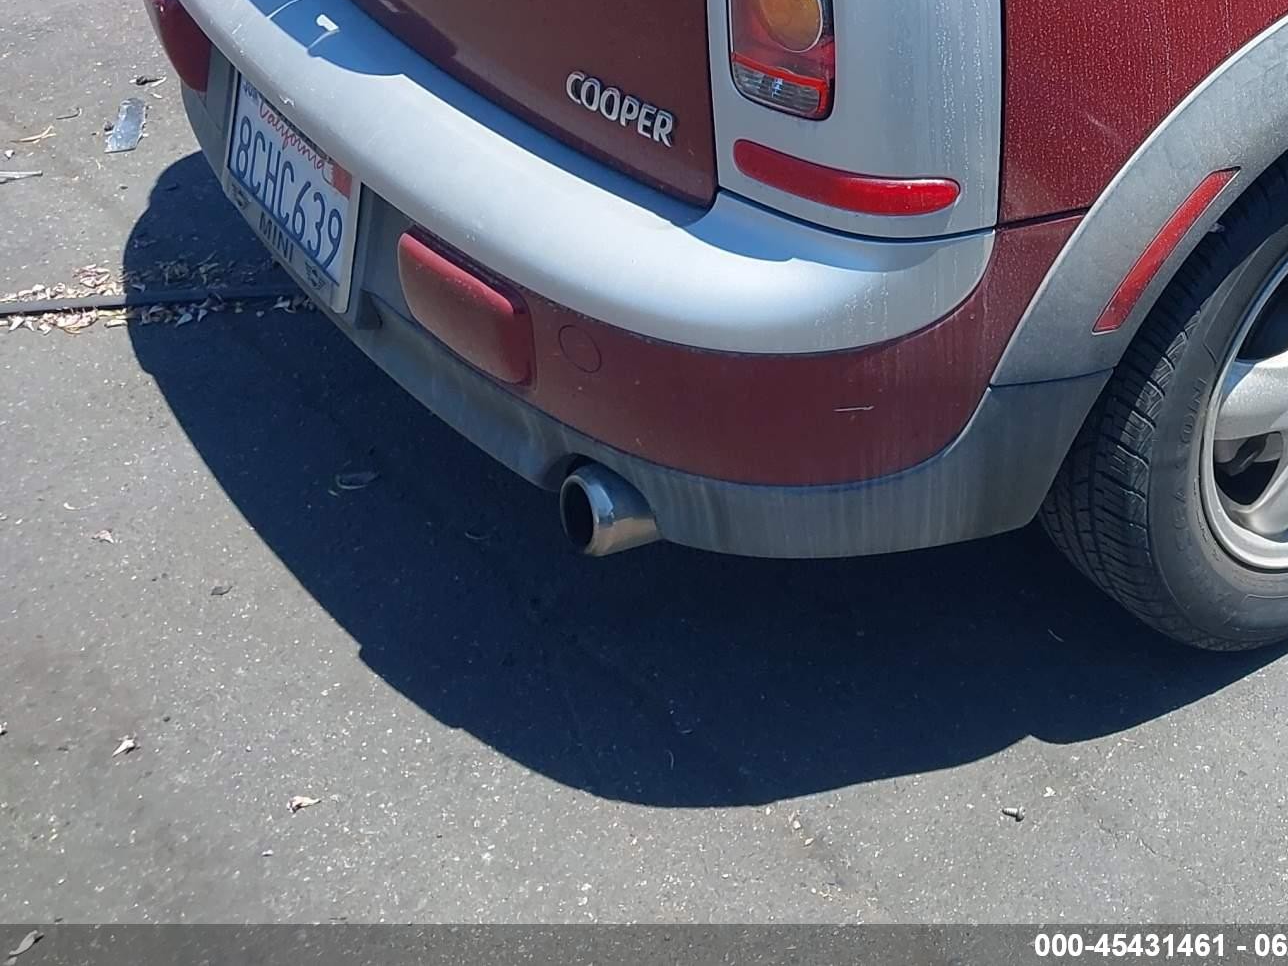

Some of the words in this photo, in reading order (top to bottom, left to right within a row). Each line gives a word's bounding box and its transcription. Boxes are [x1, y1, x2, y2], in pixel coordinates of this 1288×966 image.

[566, 71, 673, 147] COOPER
[236, 115, 343, 270] 8CHC639
[259, 211, 294, 263] MINI
